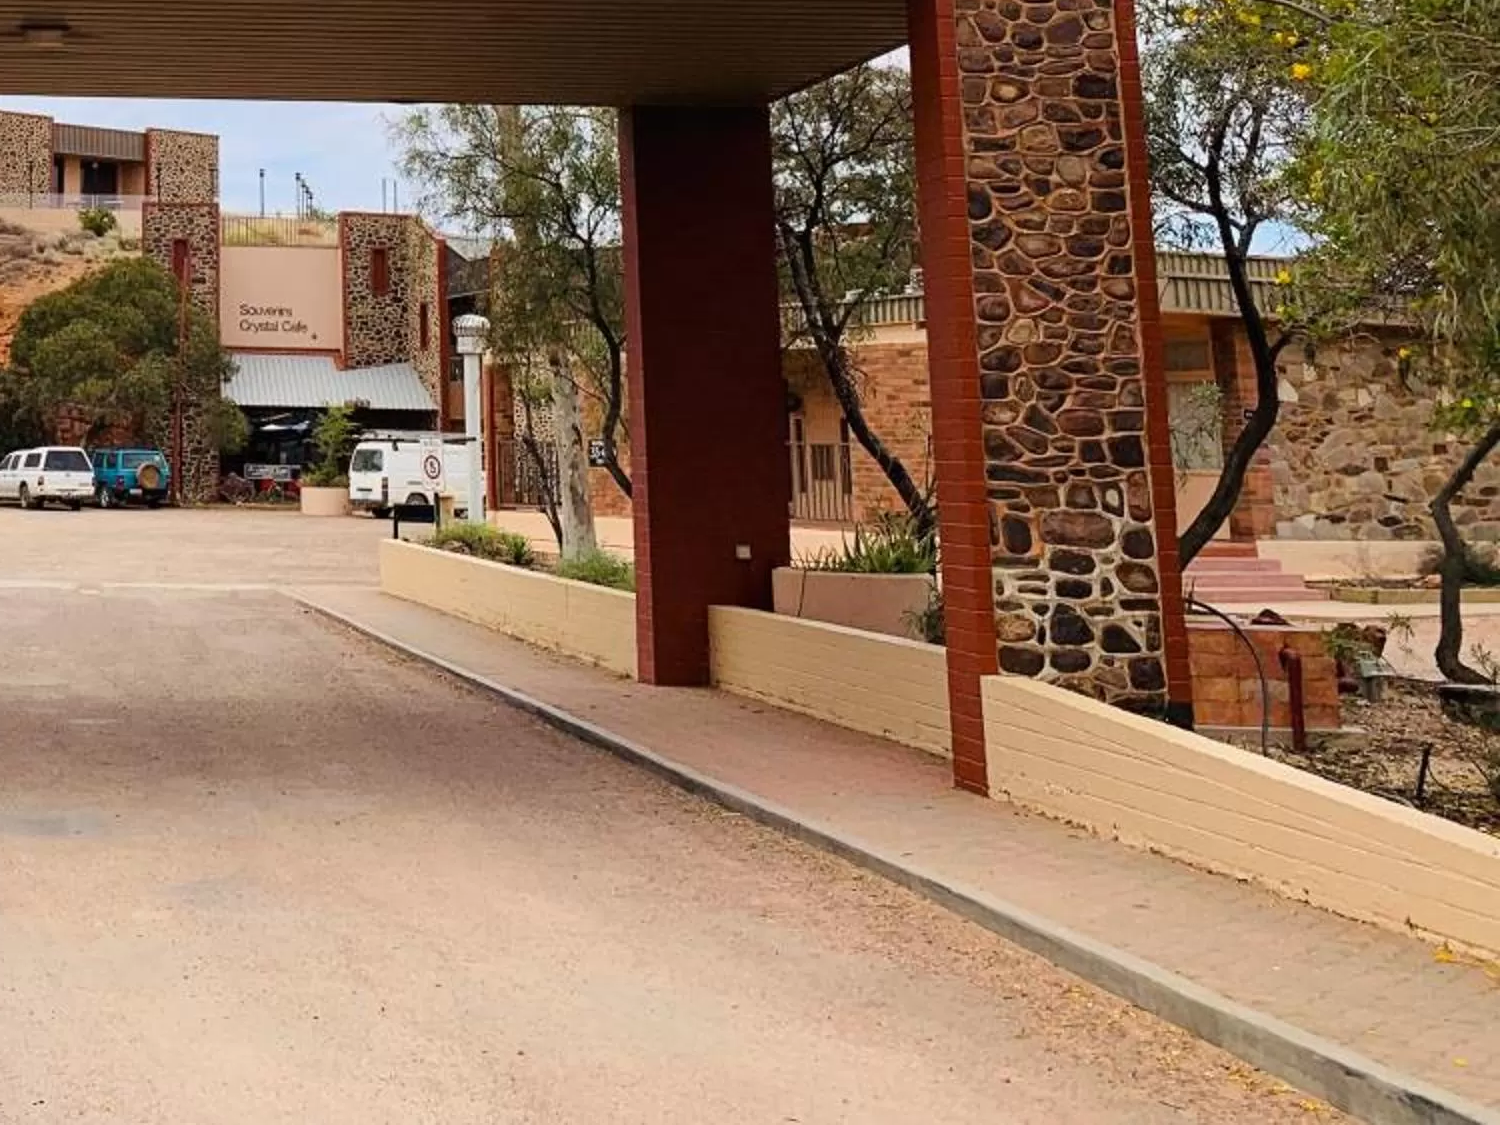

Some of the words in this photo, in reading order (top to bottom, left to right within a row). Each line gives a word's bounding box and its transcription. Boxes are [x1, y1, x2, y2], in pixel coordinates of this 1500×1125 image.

[239, 303, 293, 316] Souvenirs
[239, 319, 279, 333] Crystal
[281, 320, 308, 333] Cafe
